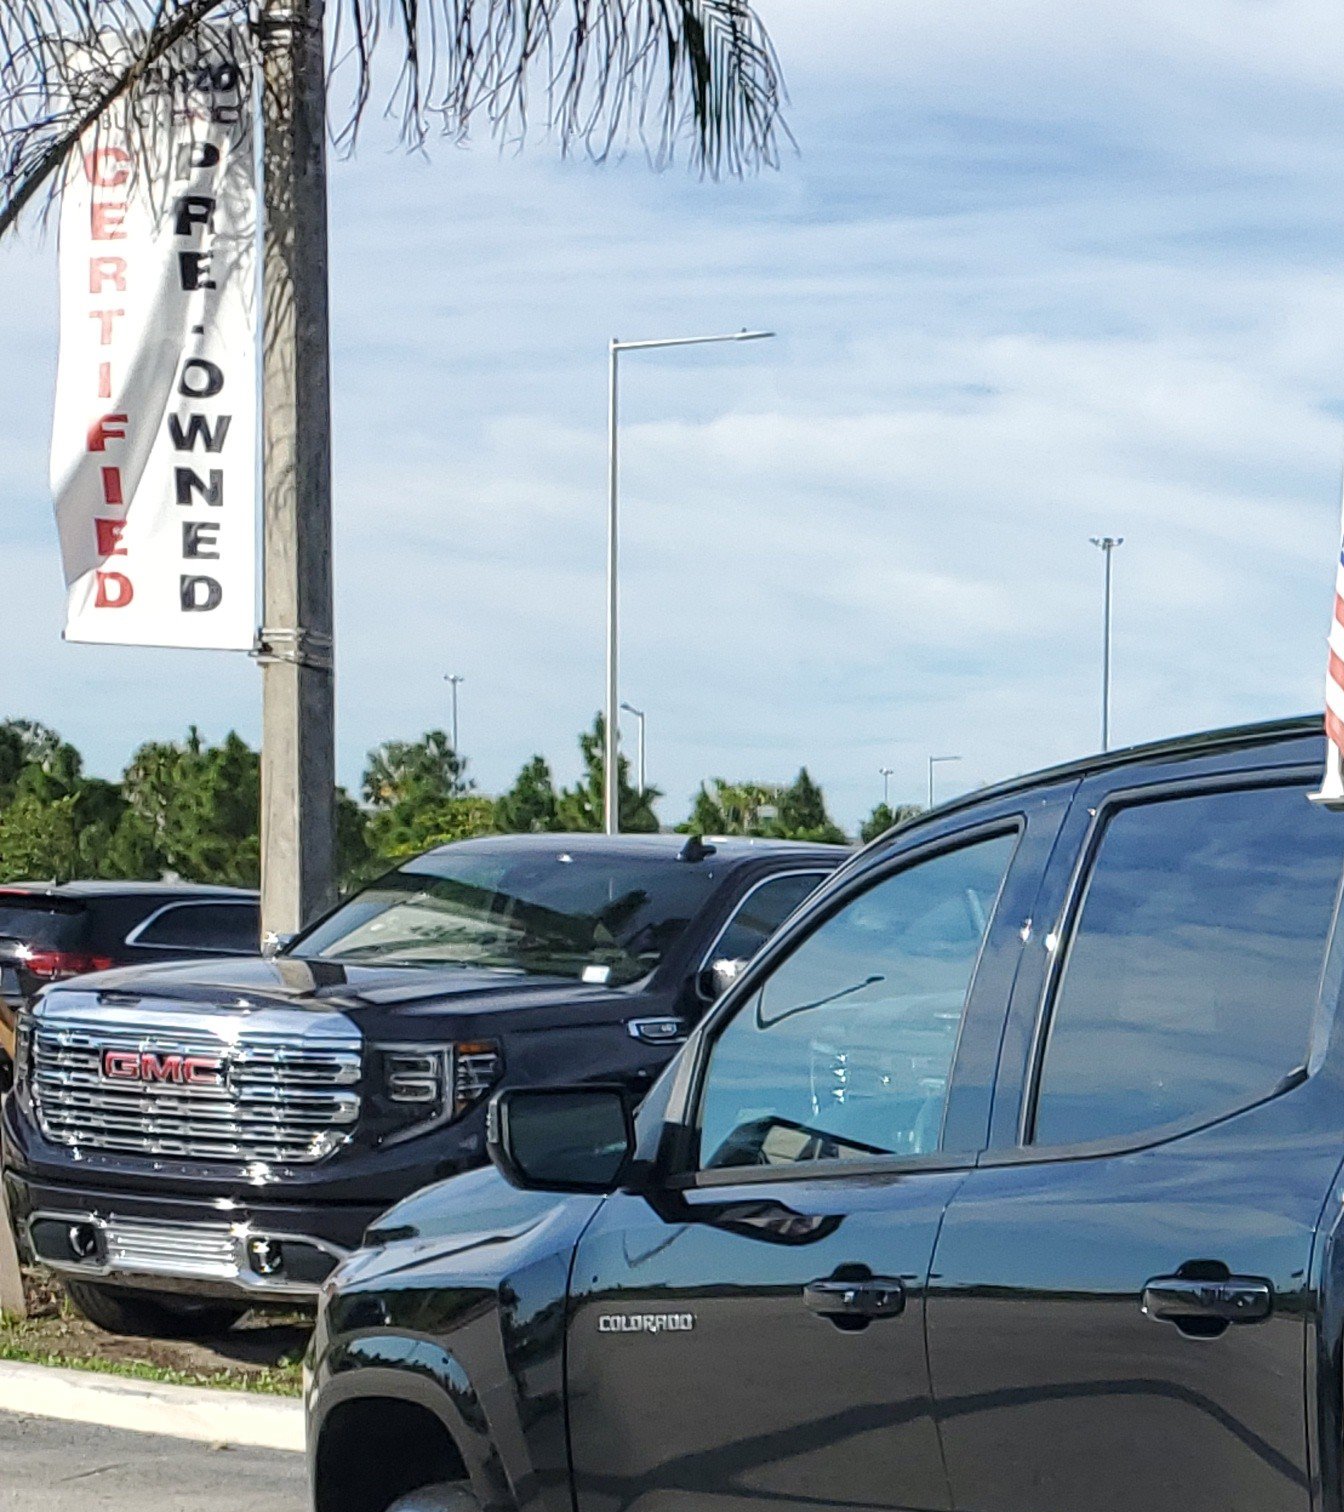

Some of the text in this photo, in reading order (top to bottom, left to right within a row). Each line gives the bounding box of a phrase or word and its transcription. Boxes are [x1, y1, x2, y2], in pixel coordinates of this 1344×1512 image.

[84, 147, 134, 609] CERTIFIED
[105, 1051, 222, 1085] GMC
[599, 1313, 693, 1332] COLORADO
